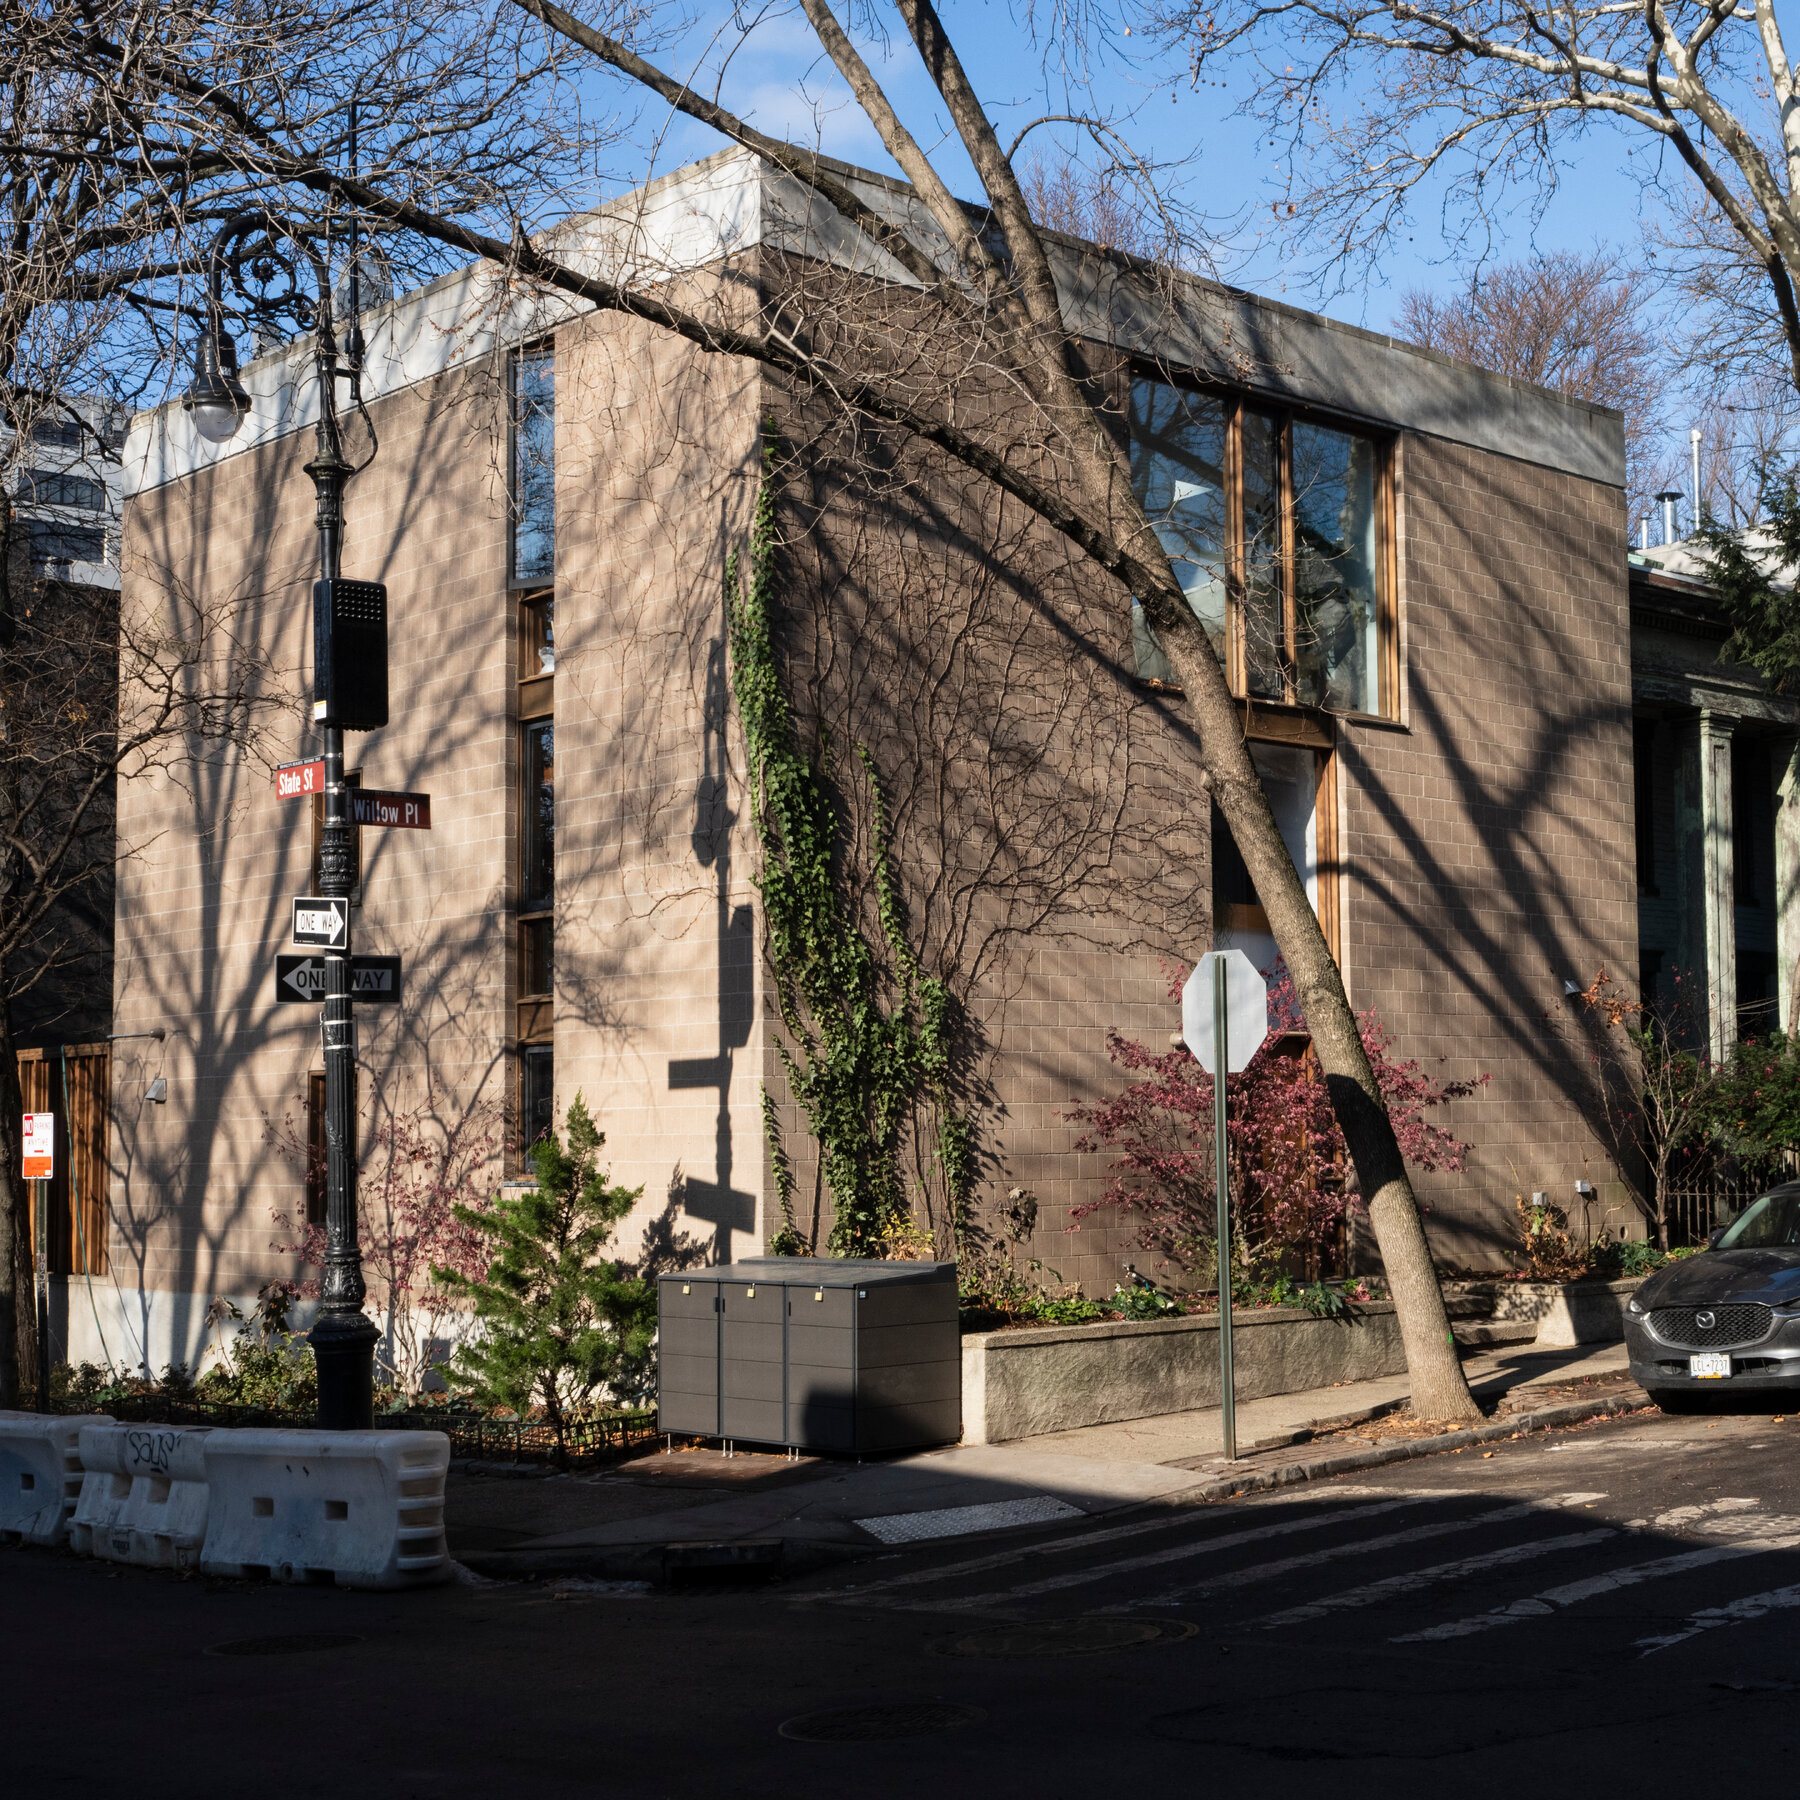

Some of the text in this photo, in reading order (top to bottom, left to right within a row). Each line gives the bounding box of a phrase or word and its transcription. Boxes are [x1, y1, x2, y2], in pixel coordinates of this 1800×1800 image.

[279, 767, 314, 796] State St
[353, 799, 419, 825] Willow Pl
[300, 912, 339, 932] ONE WAY
[24, 1119, 33, 1134] NO
